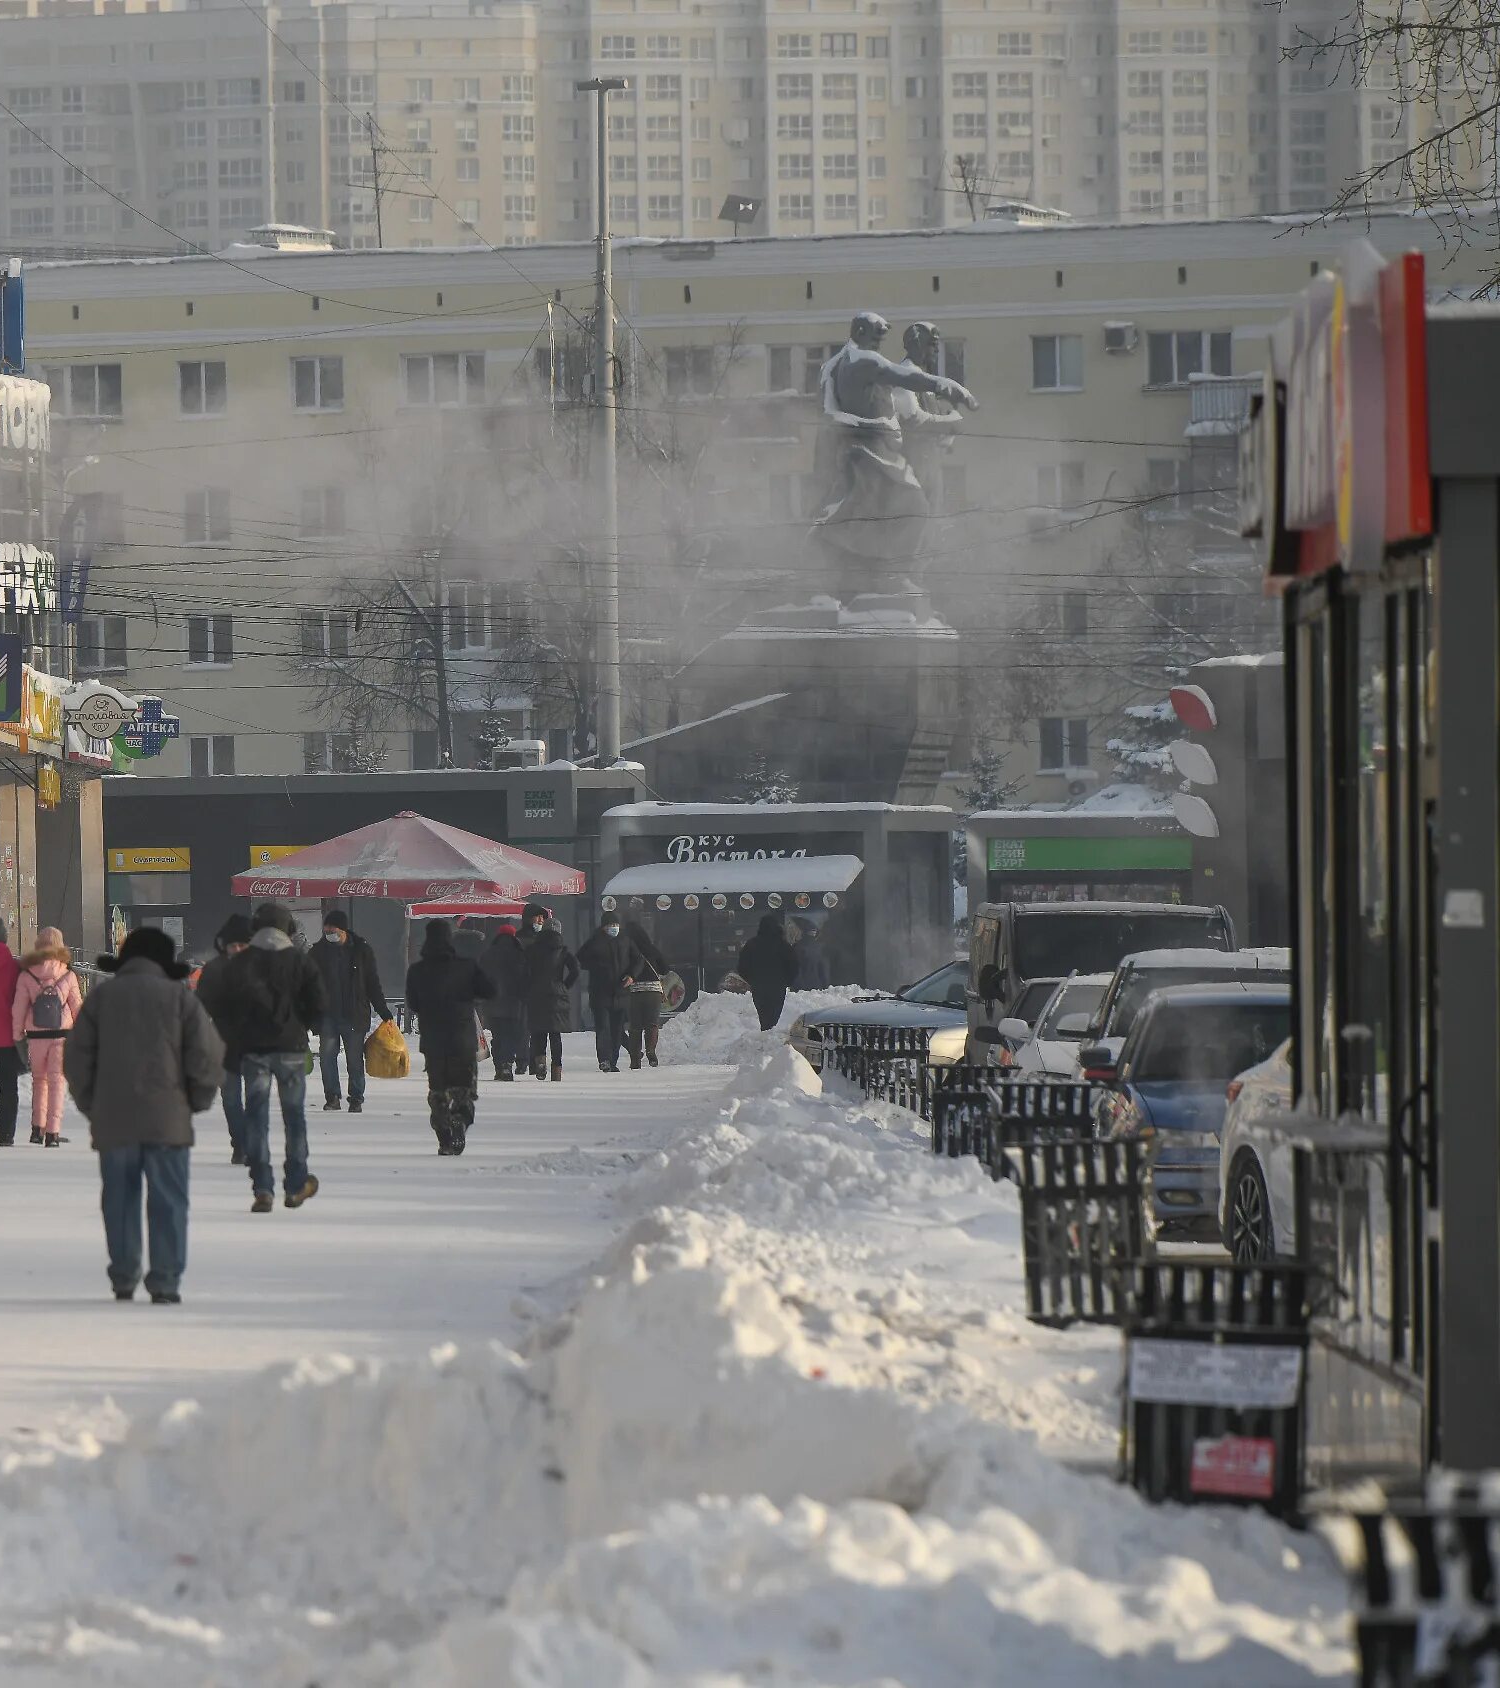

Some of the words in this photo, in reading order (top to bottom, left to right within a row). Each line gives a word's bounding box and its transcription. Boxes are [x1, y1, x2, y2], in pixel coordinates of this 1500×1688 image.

[127, 722, 176, 734] АПТЕКА
[524, 809, 555, 818] БУРГ
[994, 858, 1025, 868] БУРГ
